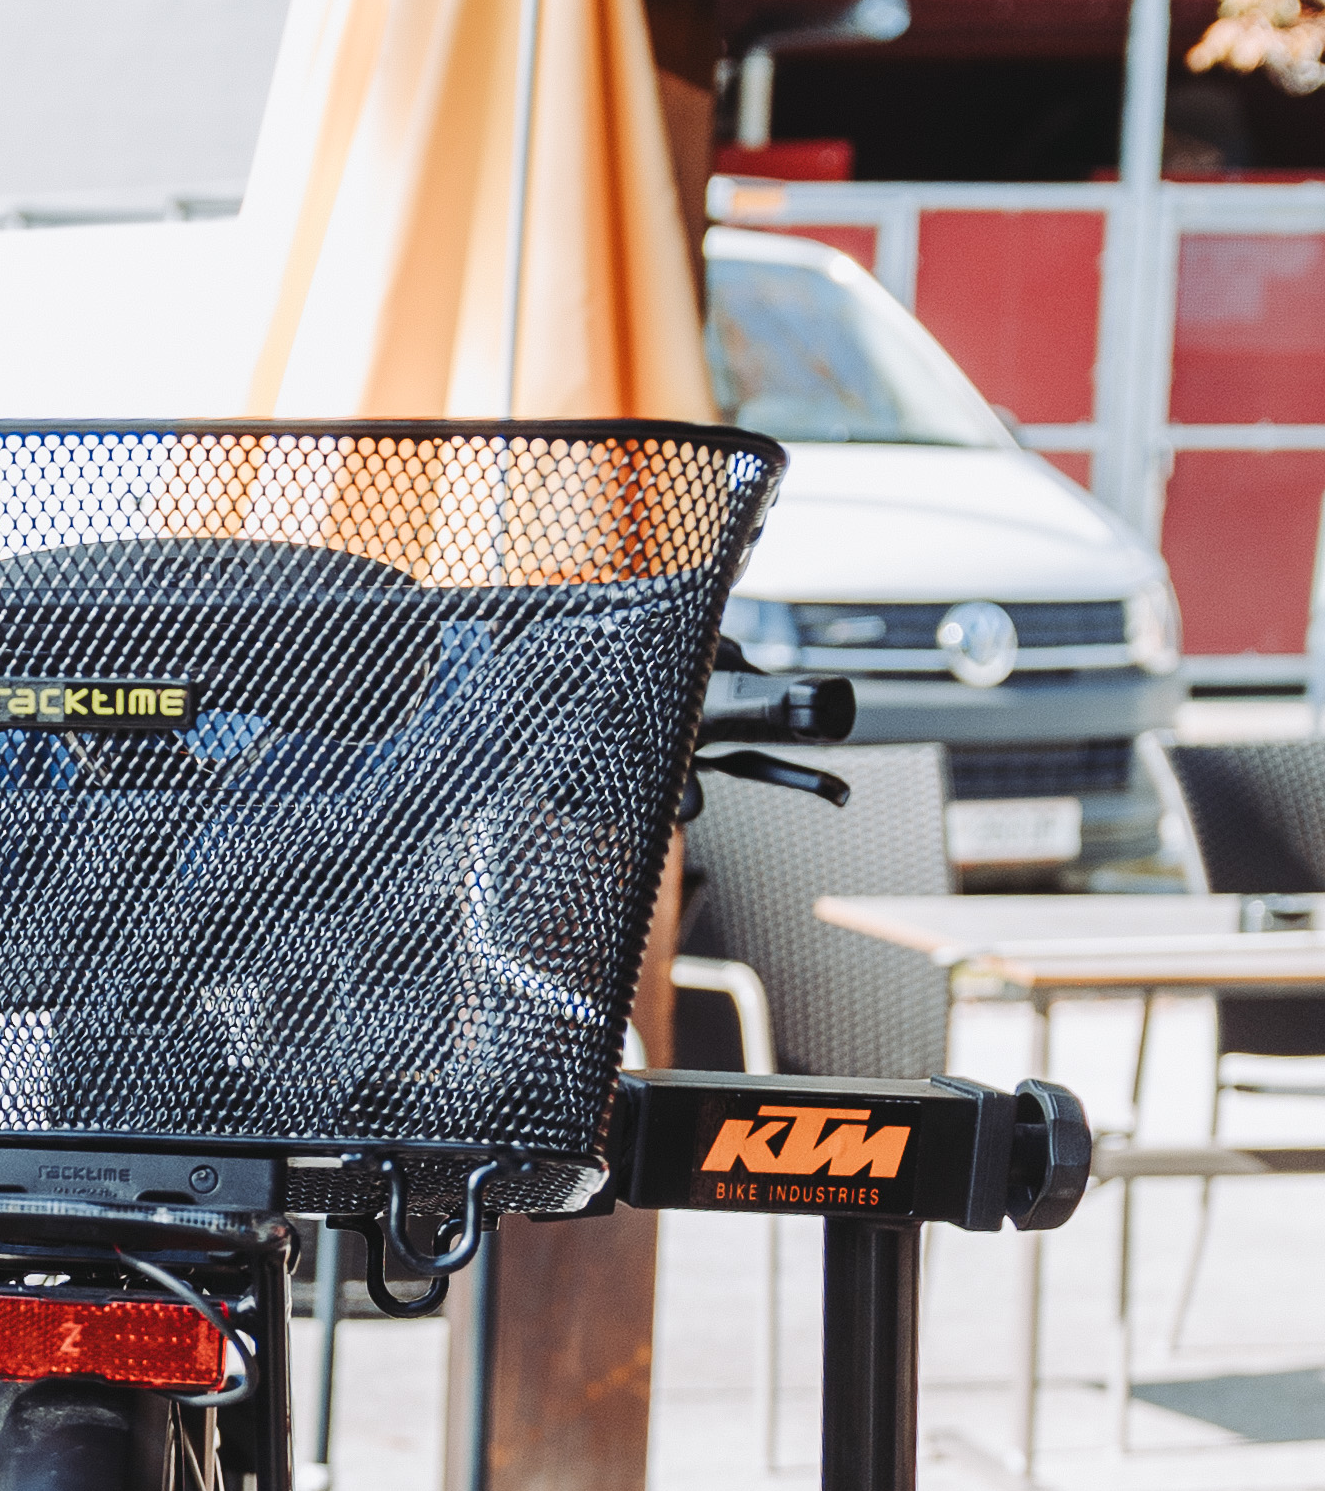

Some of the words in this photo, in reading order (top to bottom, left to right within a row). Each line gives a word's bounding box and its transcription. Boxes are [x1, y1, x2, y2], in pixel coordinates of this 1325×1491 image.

[700, 1105, 912, 1179] KTM
[716, 1182, 758, 1201] BIKE
[768, 1185, 880, 1206] INDUSTRIES
